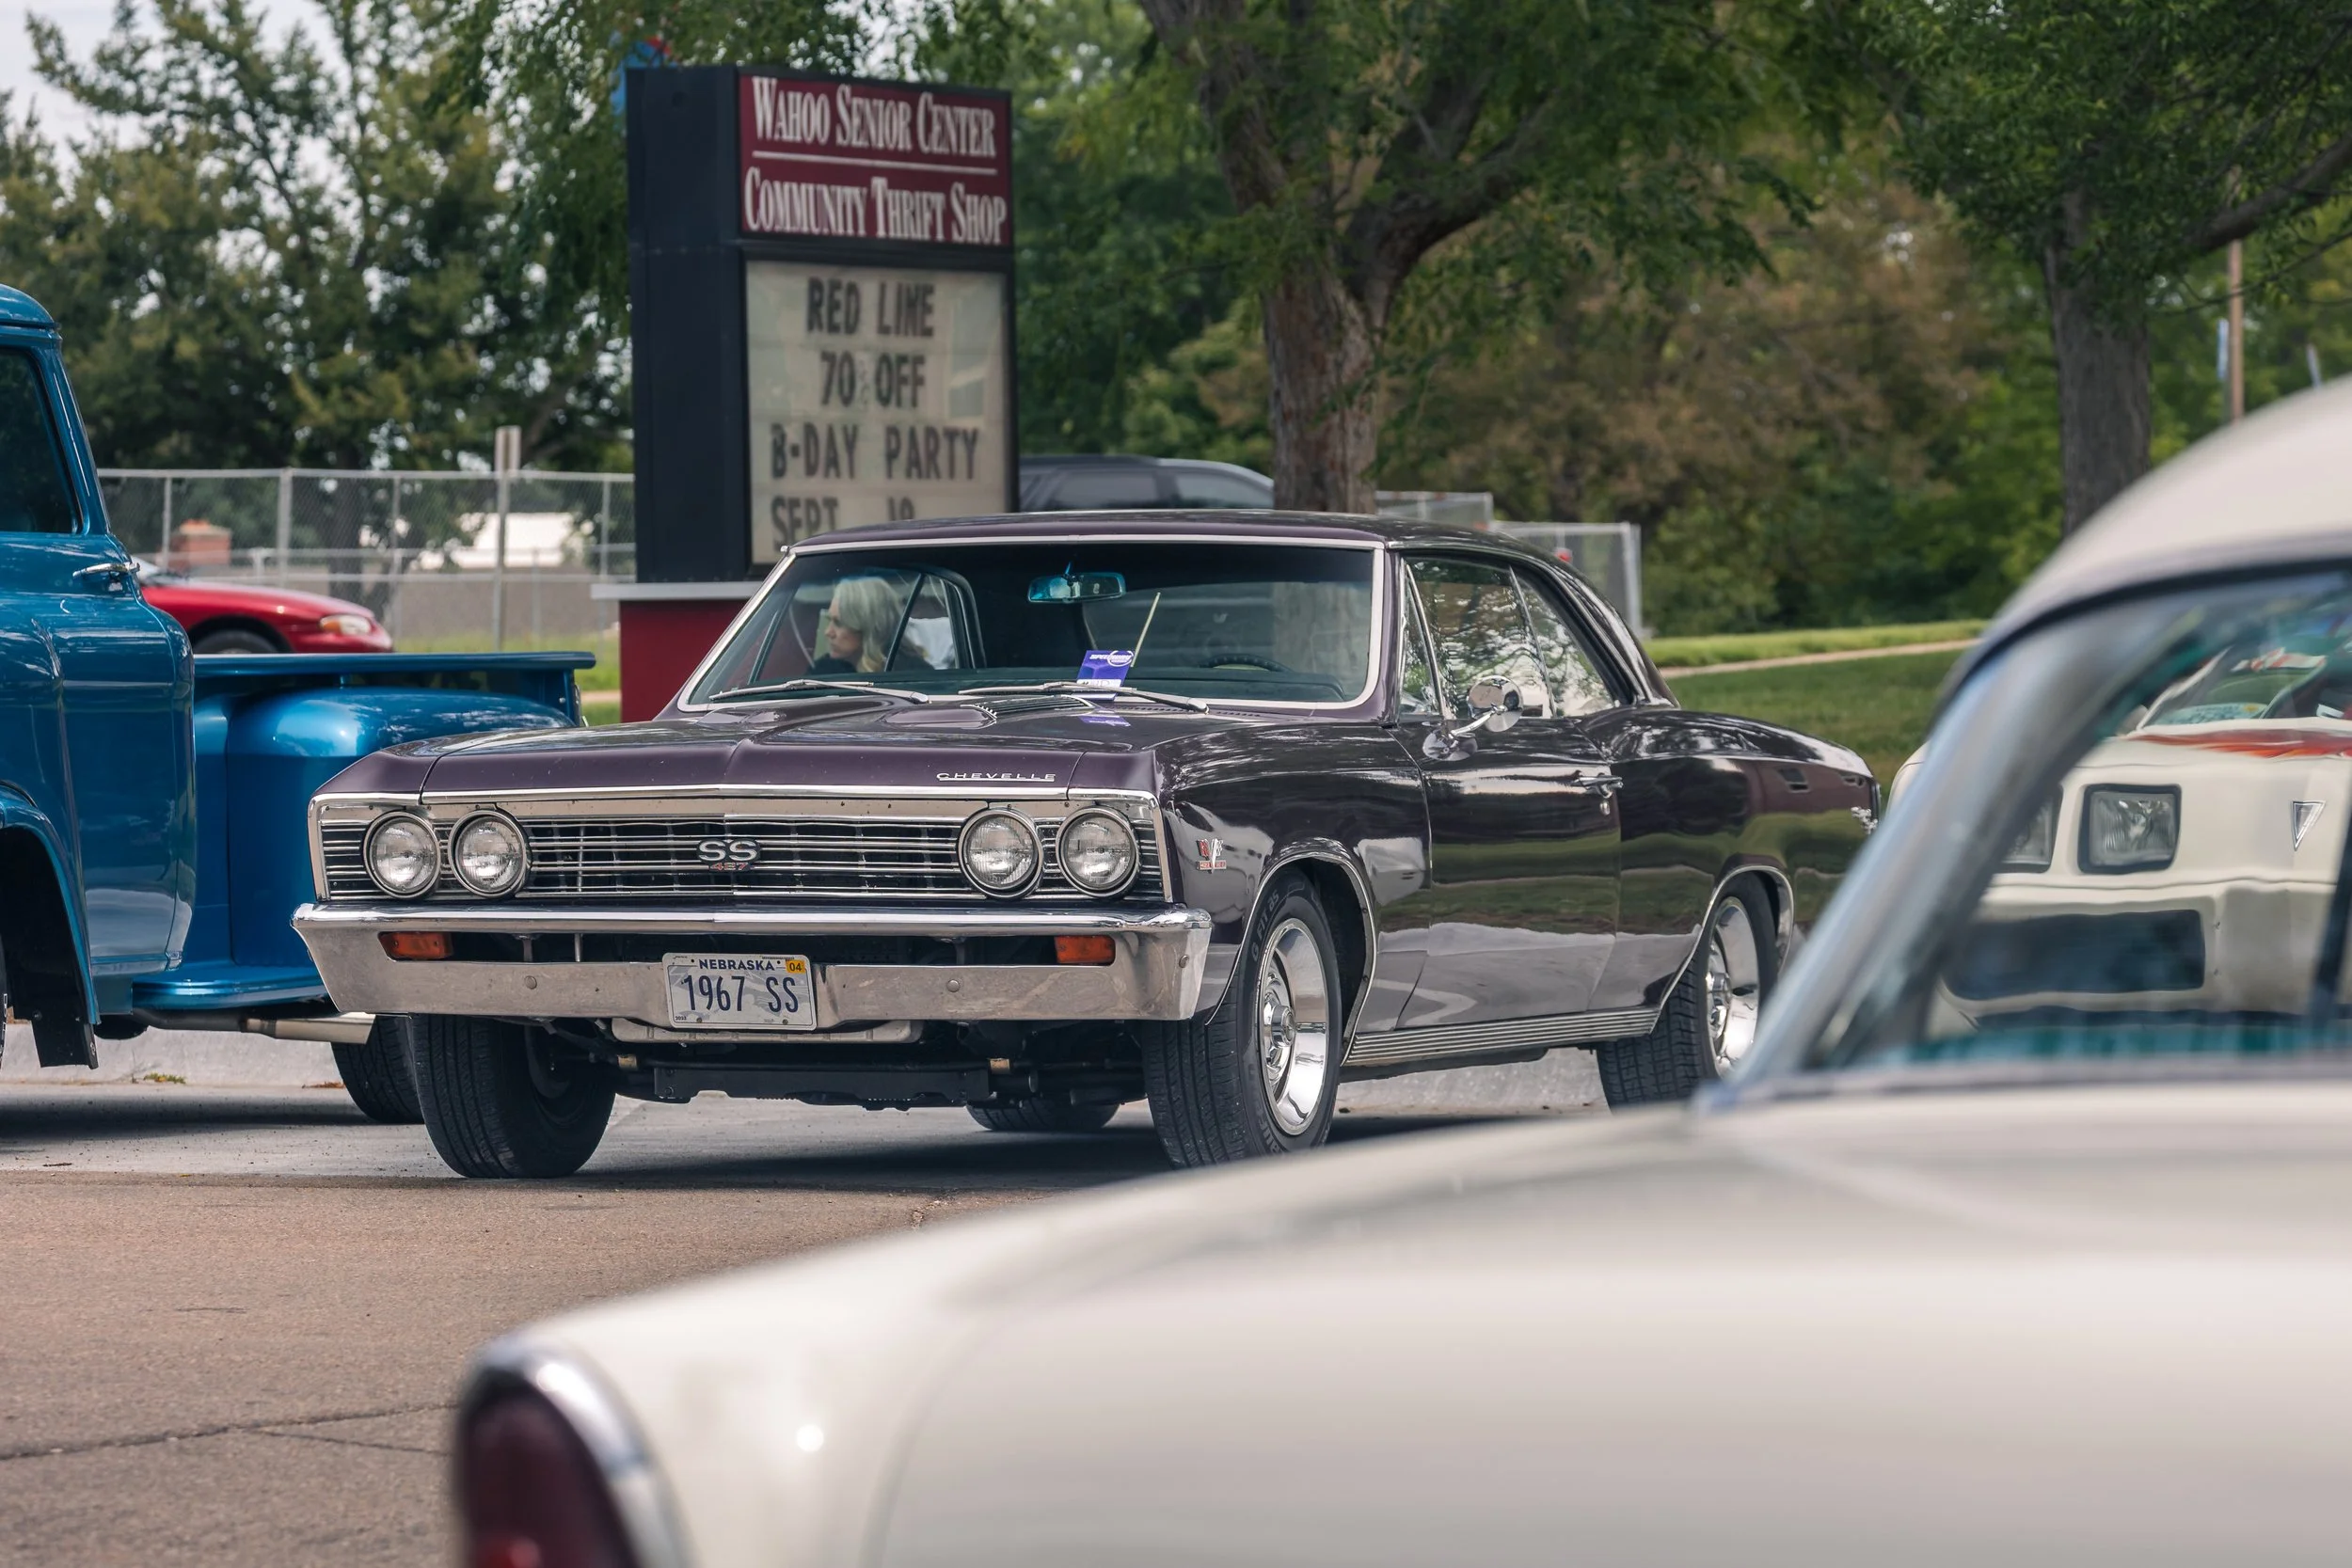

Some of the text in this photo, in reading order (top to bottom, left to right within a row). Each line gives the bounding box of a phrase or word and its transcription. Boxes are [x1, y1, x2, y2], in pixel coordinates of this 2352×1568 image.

[752, 75, 996, 158] WAHOO SENIOR CENTER
[744, 166, 1008, 245] COMMUNITY THRIFT SHOP
[806, 277, 934, 338] RED LINE
[874, 353, 926, 408] OFF
[771, 423, 977, 481] B-DAY PARTY
[936, 772, 1056, 781] CHEVELLE
[699, 841, 757, 861] SS
[710, 863, 749, 871] 427
[699, 959, 775, 971] NEBRASKA
[789, 962, 803, 972] 04
[683, 974, 799, 1013] 1967 SS
